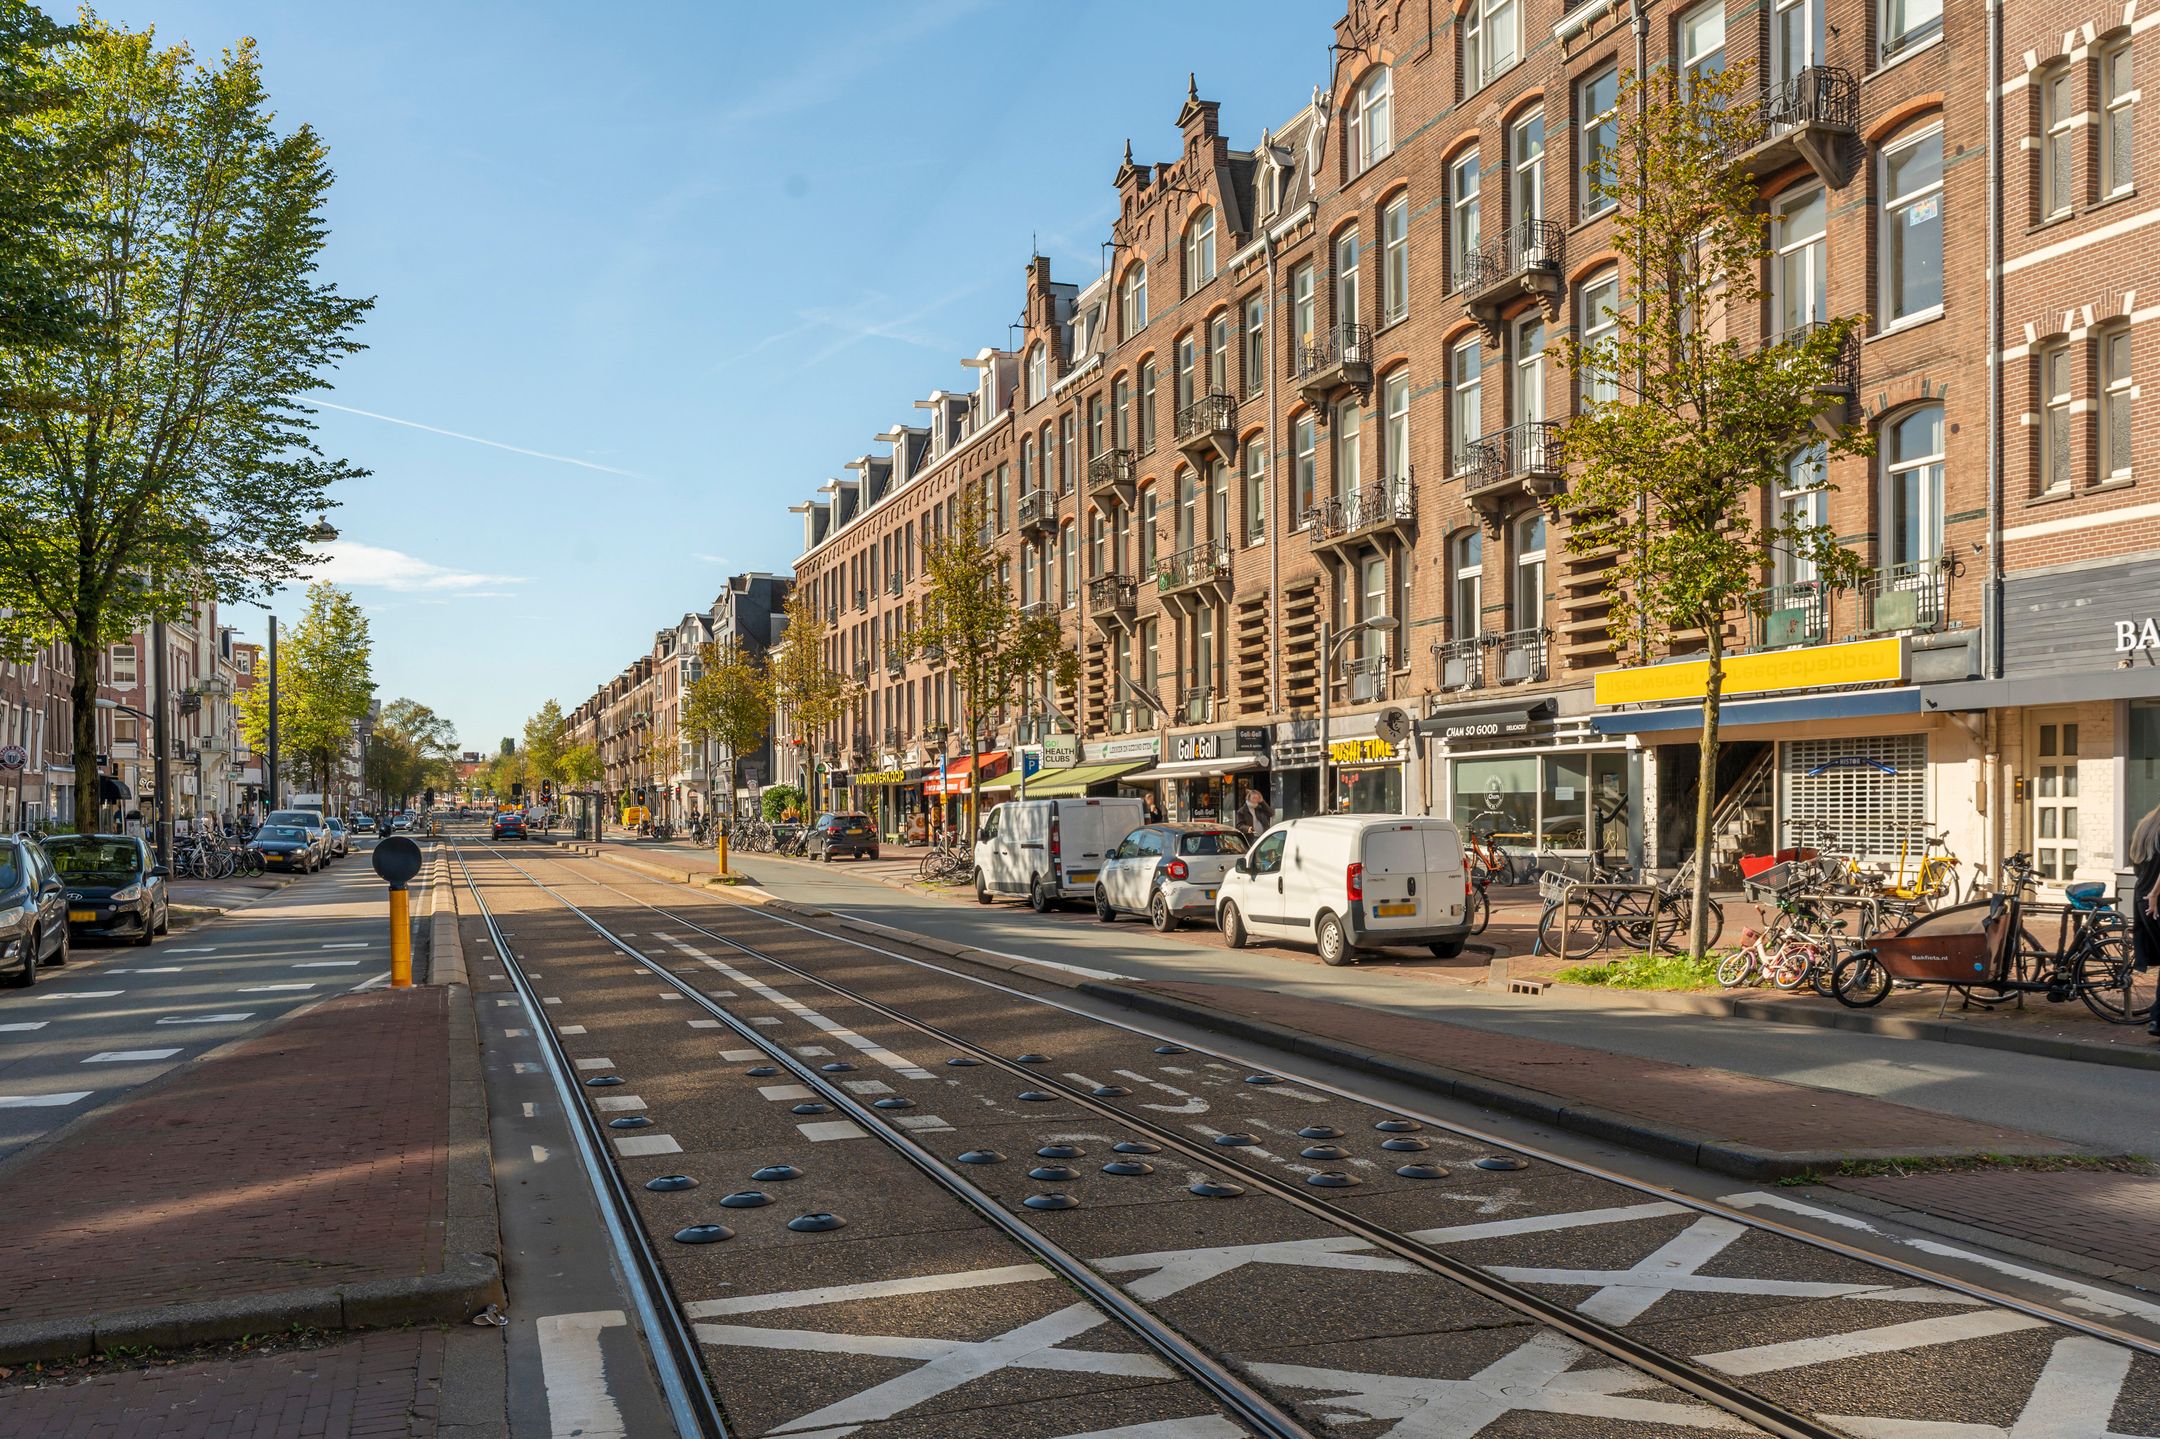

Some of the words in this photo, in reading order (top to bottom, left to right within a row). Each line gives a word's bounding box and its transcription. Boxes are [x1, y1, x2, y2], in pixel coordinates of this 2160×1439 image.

[2114, 617, 2160, 652] BA
[1446, 726, 1465, 738] CHAM
[1465, 725, 1476, 736] SO
[1476, 723, 1498, 736] GOOD
[1045, 748, 1075, 756] HEALTH
[1028, 760, 1036, 771] P
[1045, 755, 1071, 763] CLUBS
[855, 770, 905, 785] AVONDVERKOOP
